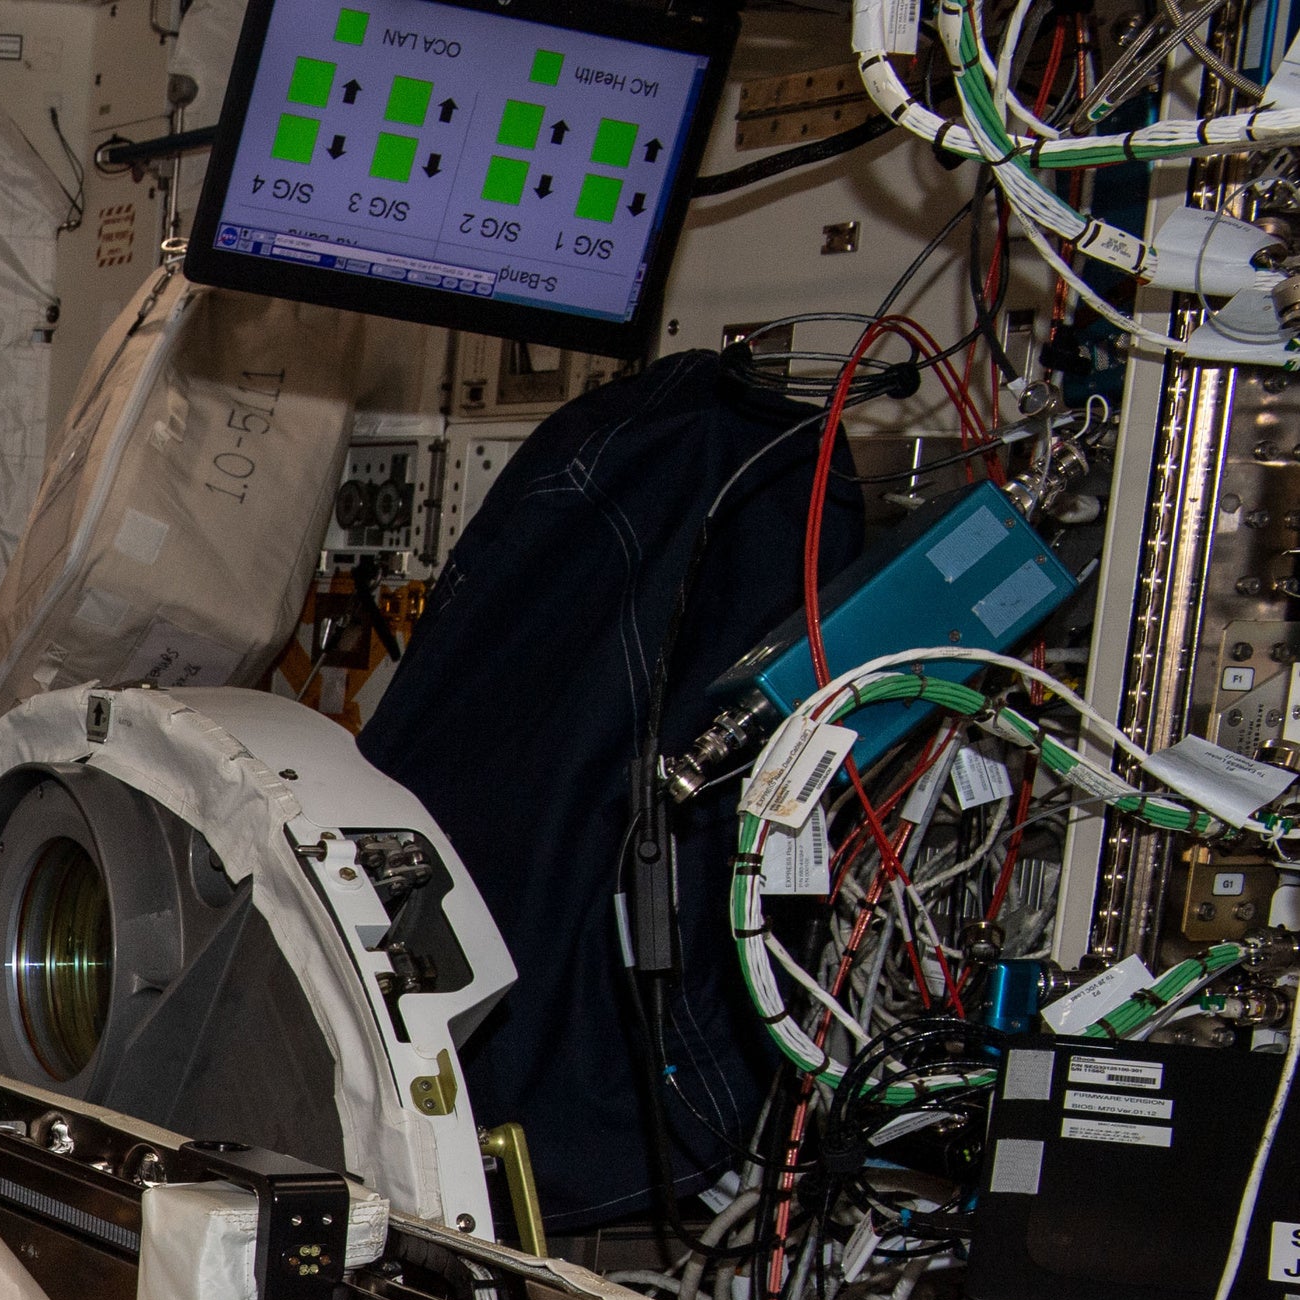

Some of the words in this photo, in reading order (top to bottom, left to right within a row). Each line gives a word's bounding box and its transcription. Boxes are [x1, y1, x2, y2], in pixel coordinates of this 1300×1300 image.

[383, 28, 419, 51] LAN
[423, 37, 462, 58] OCA
[575, 65, 628, 91] Health
[630, 78, 660, 98] IAC
[252, 174, 265, 190] 4
[272, 179, 314, 204] S/G
[349, 192, 360, 212] 3
[369, 196, 411, 222] S/G
[459, 213, 472, 233] 2
[481, 217, 522, 242] S/G
[556, 230, 563, 250] 1
[575, 235, 615, 260] S/G
[499, 268, 558, 293] S-Band
[1232, 675, 1243, 683] F1
[1222, 880, 1234, 889] G1
[1073, 1092, 1122, 1102] FIRMWARE
[1123, 1096, 1166, 1107] VERSION
